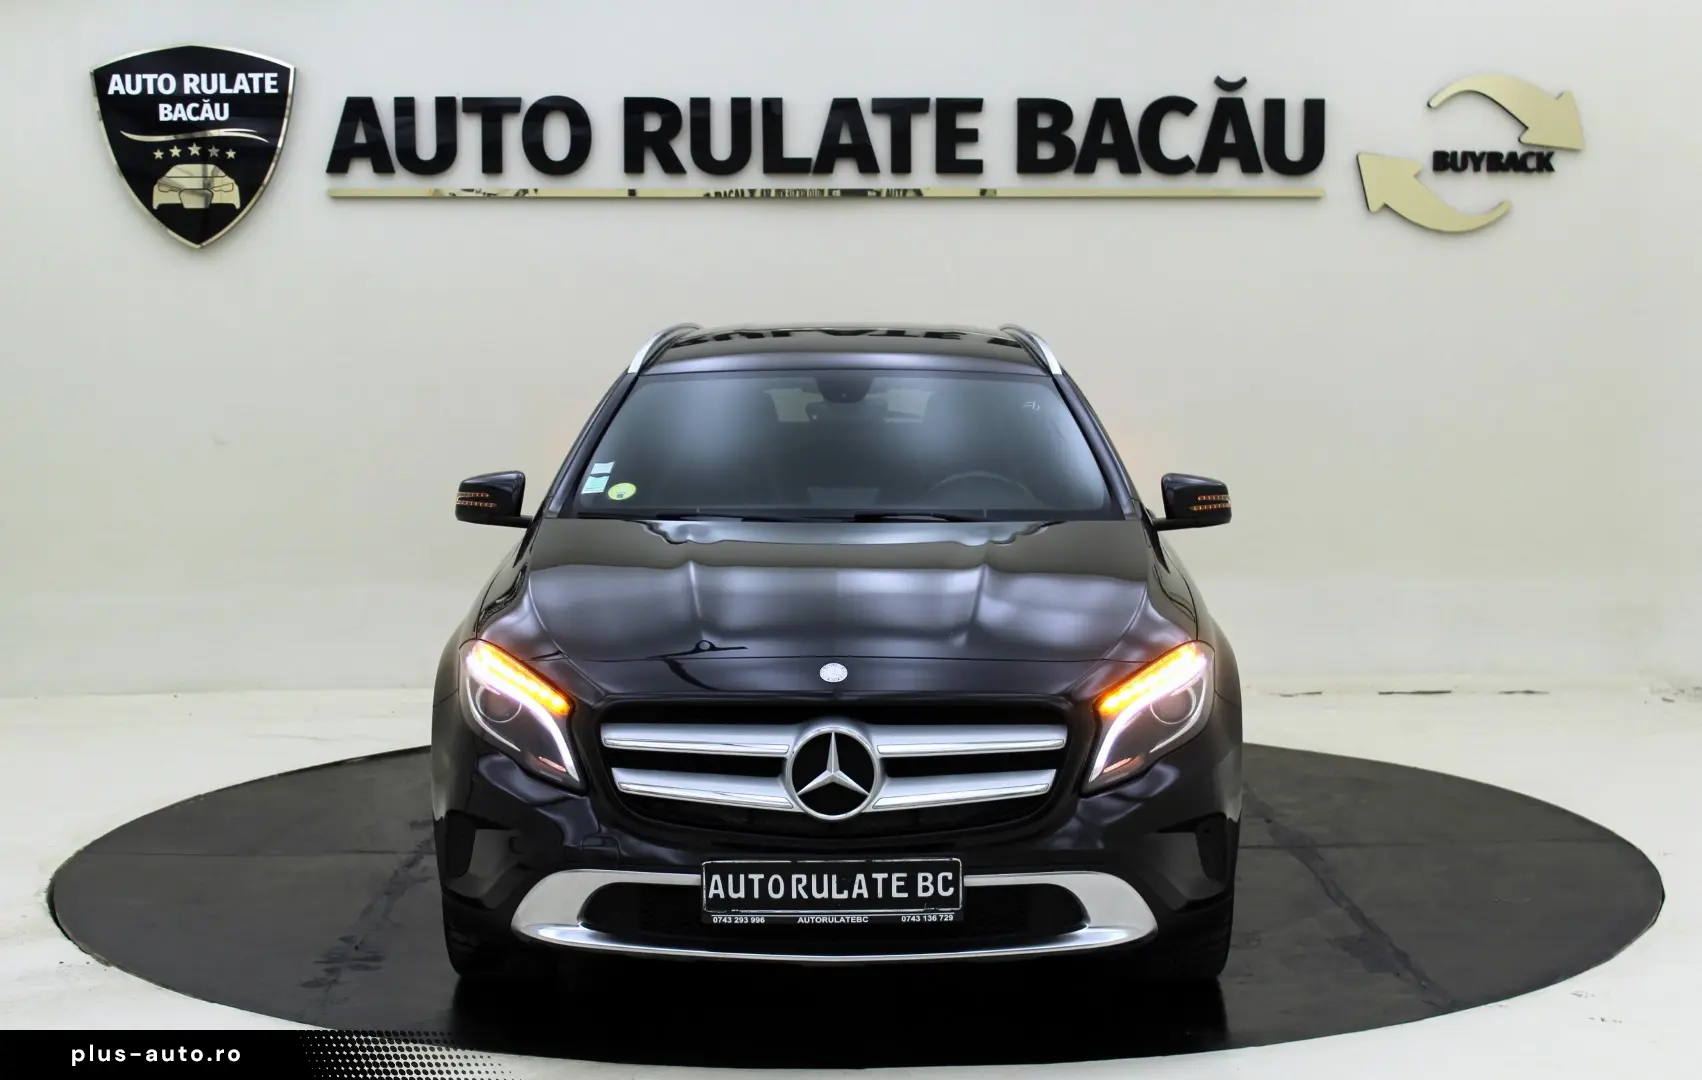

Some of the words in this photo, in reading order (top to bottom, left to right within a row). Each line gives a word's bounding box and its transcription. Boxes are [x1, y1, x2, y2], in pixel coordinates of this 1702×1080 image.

[108, 73, 177, 96] AUTO
[183, 72, 279, 95] RULATE
[158, 98, 230, 122] BACĂU
[326, 95, 592, 175] AUTO
[624, 96, 984, 176] RULATE
[1017, 76, 1326, 176] BACĂU
[1432, 149, 1556, 174] BUYBACK
[917, 871, 955, 898] BC
[712, 916, 732, 924] 0743
[733, 916, 749, 924] 293
[797, 916, 869, 924] AUTORULATEBC
[901, 914, 921, 922] 0743
[939, 913, 954, 922] 729
